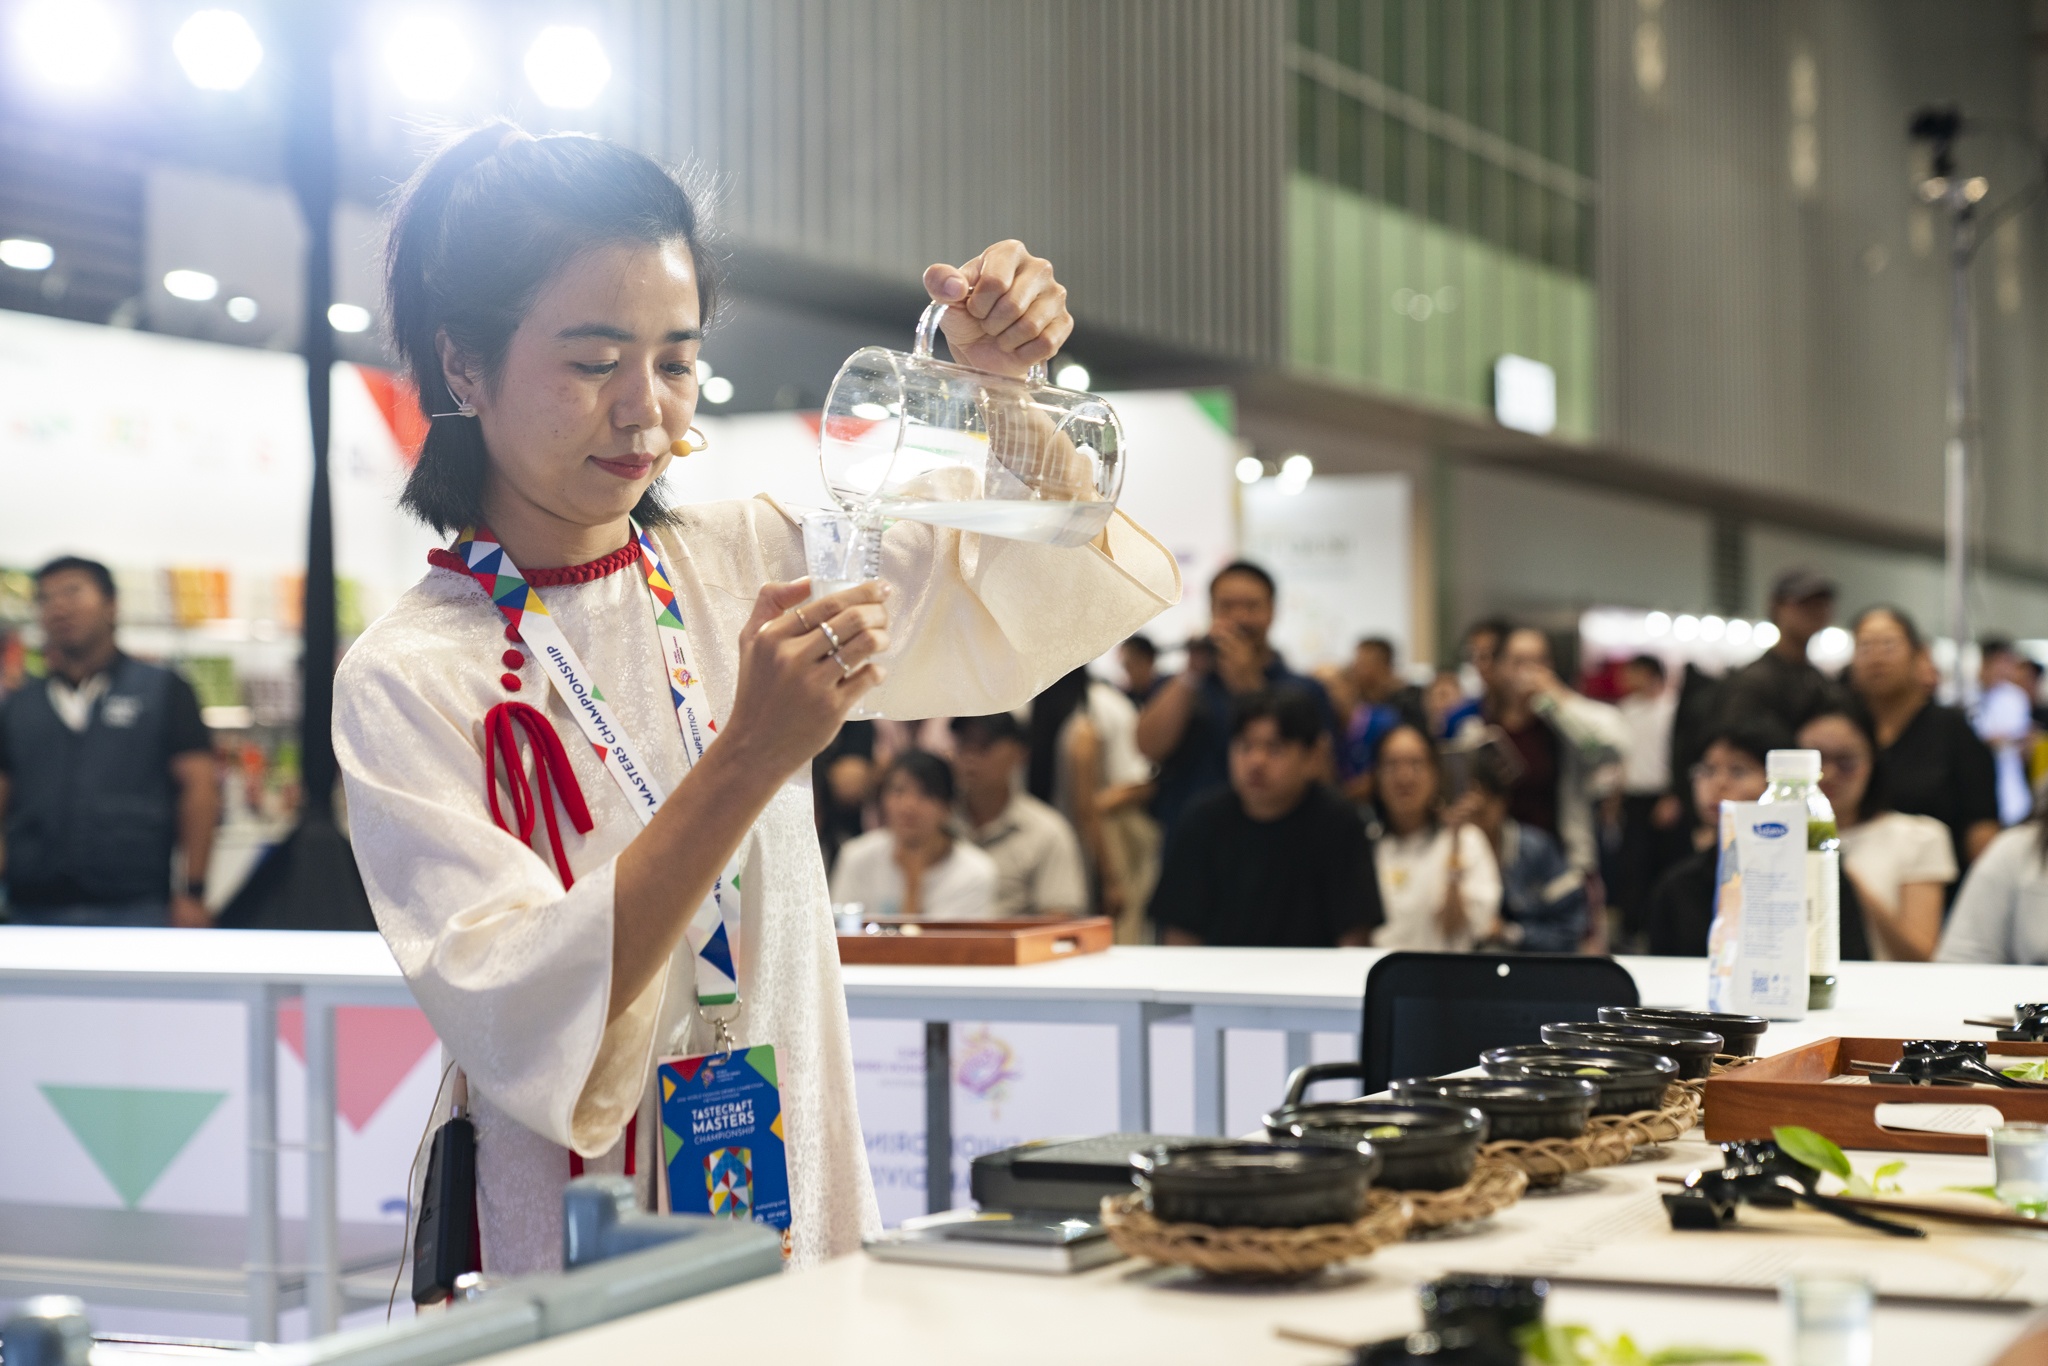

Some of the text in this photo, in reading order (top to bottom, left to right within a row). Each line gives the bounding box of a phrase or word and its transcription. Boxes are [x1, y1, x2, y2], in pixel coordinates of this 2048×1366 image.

[546, 645, 656, 806] MASTERS CHAMPIONSHIP
[686, 706, 704, 759] MPETITION
[691, 1099, 753, 1120] TASTECRAFT
[692, 1110, 755, 1135] MASTERS
[694, 1125, 755, 1146] CHAMPIONSHIP
